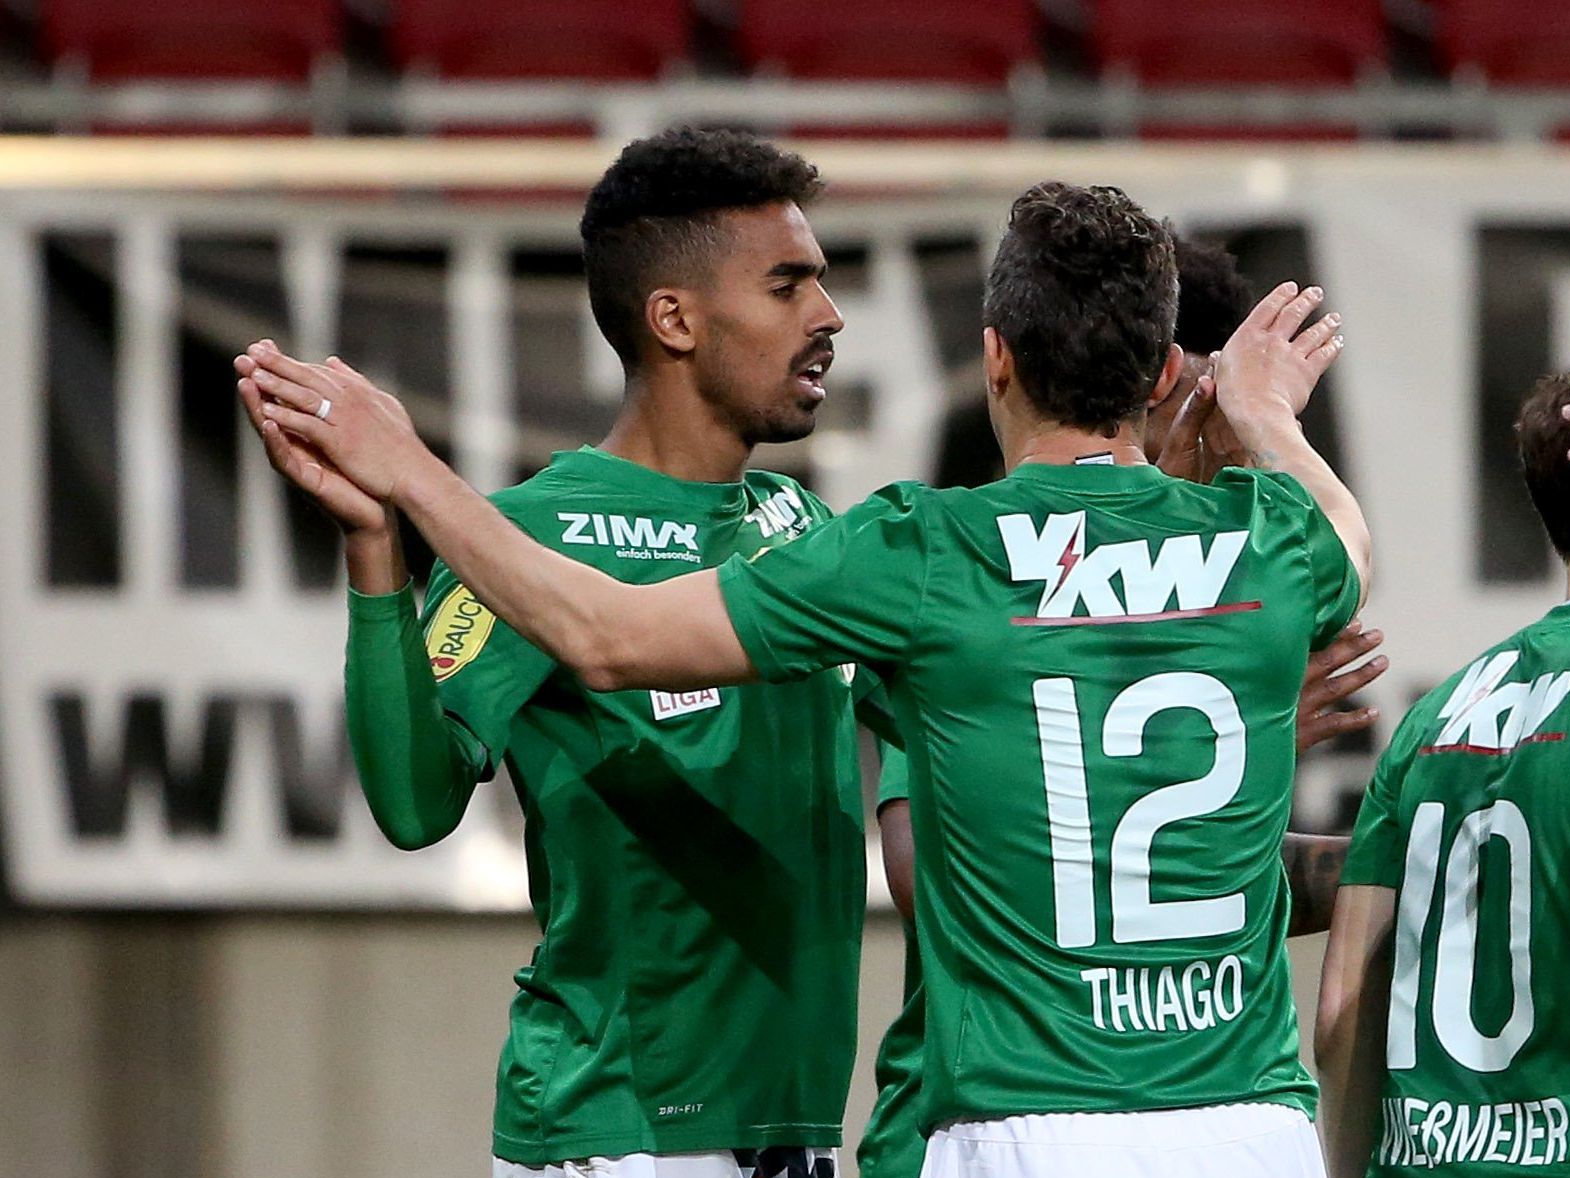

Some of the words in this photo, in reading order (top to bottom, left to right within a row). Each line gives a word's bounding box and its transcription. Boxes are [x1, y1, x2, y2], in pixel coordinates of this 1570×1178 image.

[616, 548, 651, 559] einfach
[653, 550, 701, 563] besonders
[656, 690, 714, 713] LIGA
[1032, 671, 1247, 949] 12
[1386, 799, 1535, 1072] 10
[1080, 954, 1244, 1032] THIAGO
[658, 1104, 703, 1116] DRI-FIT
